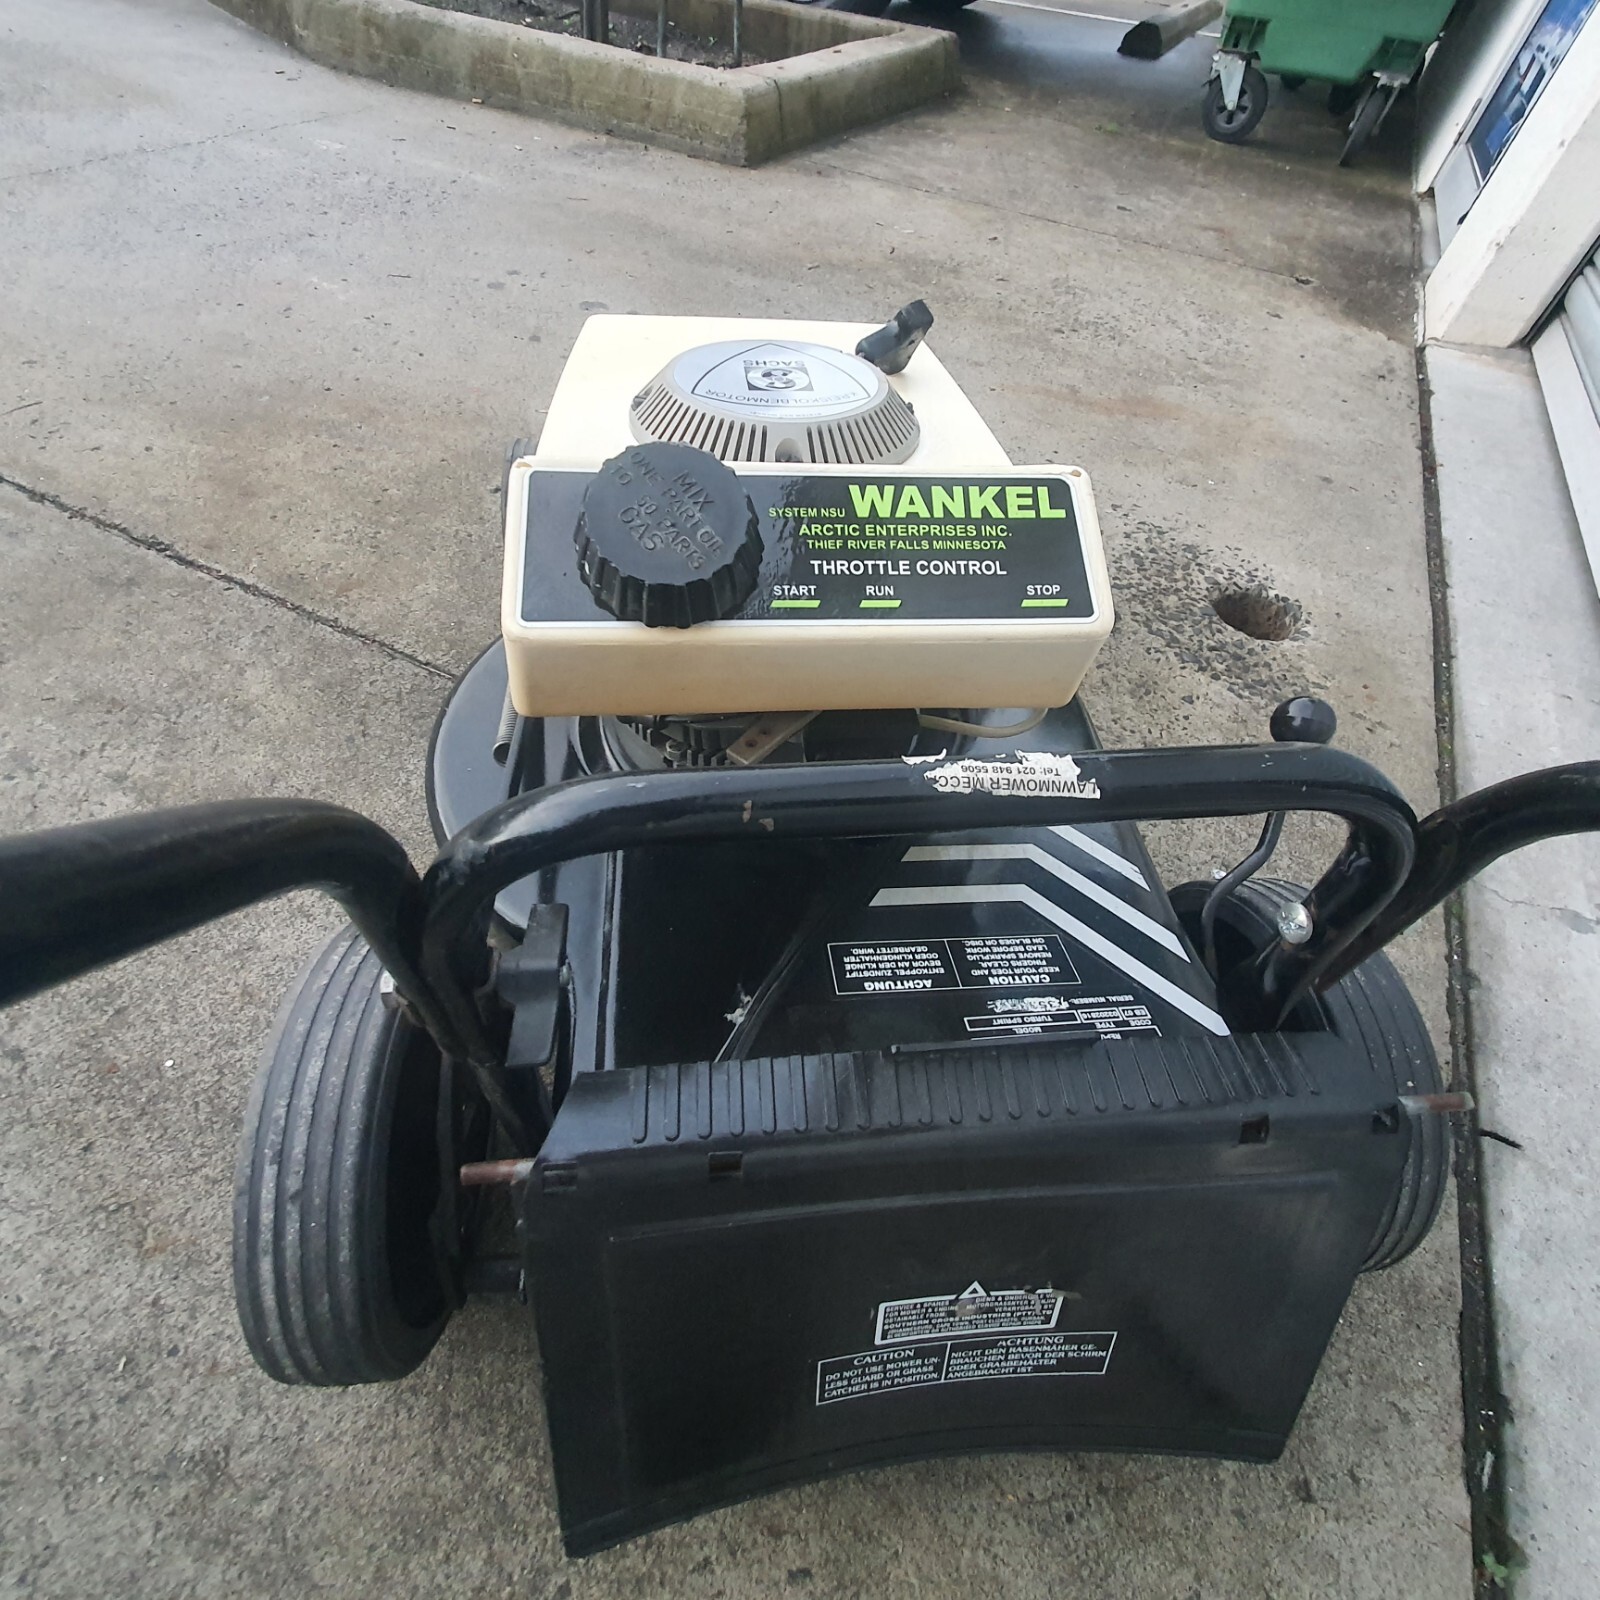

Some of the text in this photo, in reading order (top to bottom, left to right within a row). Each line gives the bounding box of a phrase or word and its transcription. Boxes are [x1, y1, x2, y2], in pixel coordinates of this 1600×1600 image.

[631, 452, 664, 486] ONE
[662, 488, 706, 528] PART
[672, 470, 715, 511] MIX
[849, 485, 1066, 518] WANKEL
[610, 463, 632, 486] TO
[657, 519, 706, 570] PARTS
[769, 508, 846, 518] SYSTEM NSU
[618, 506, 665, 551] GAS
[799, 524, 1012, 536] ARCTIC ENTERPRISES INC.
[808, 540, 1006, 550] THIEF RIVER FALLS MINNESOTA
[810, 560, 1007, 575] THROTTLE CONTROL
[773, 585, 1060, 596] START RUN STOP
[961, 765, 1061, 776] Tel: 021 948 5506
[990, 777, 1097, 794] LAWNMOWER
[844, 954, 912, 962] KLINGENHALTER
[894, 967, 944, 975] ENTKOPPEL
[864, 979, 932, 990] ACHTUNG
[988, 974, 1050, 985] CAUTION
[993, 1017, 1022, 1025] SPRINT
[884, 1320, 929, 1329] SOUTHERN
[961, 1311, 1012, 1320] INDUSTRIES
[997, 1336, 1064, 1346] ACHTUNG
[854, 1349, 915, 1365] CAUTION
[951, 1350, 982, 1358] NICHT
[985, 1347, 1006, 1355] DEN
[950, 1355, 1005, 1365] BRAUCHEN
[826, 1373, 840, 1381] DO
[843, 1369, 863, 1378] NOT
[866, 1365, 883, 1373] USE
[887, 1359, 921, 1370] MOWER
[947, 1367, 1015, 1379] ANGEBRACHT
[949, 1363, 976, 1371] ODER
[825, 1365, 934, 1389] LESS GUARD OR GRASS
[824, 1384, 867, 1398] CATCHER
[882, 1378, 892, 1386] IN
[894, 1372, 939, 1384] POSITION.
